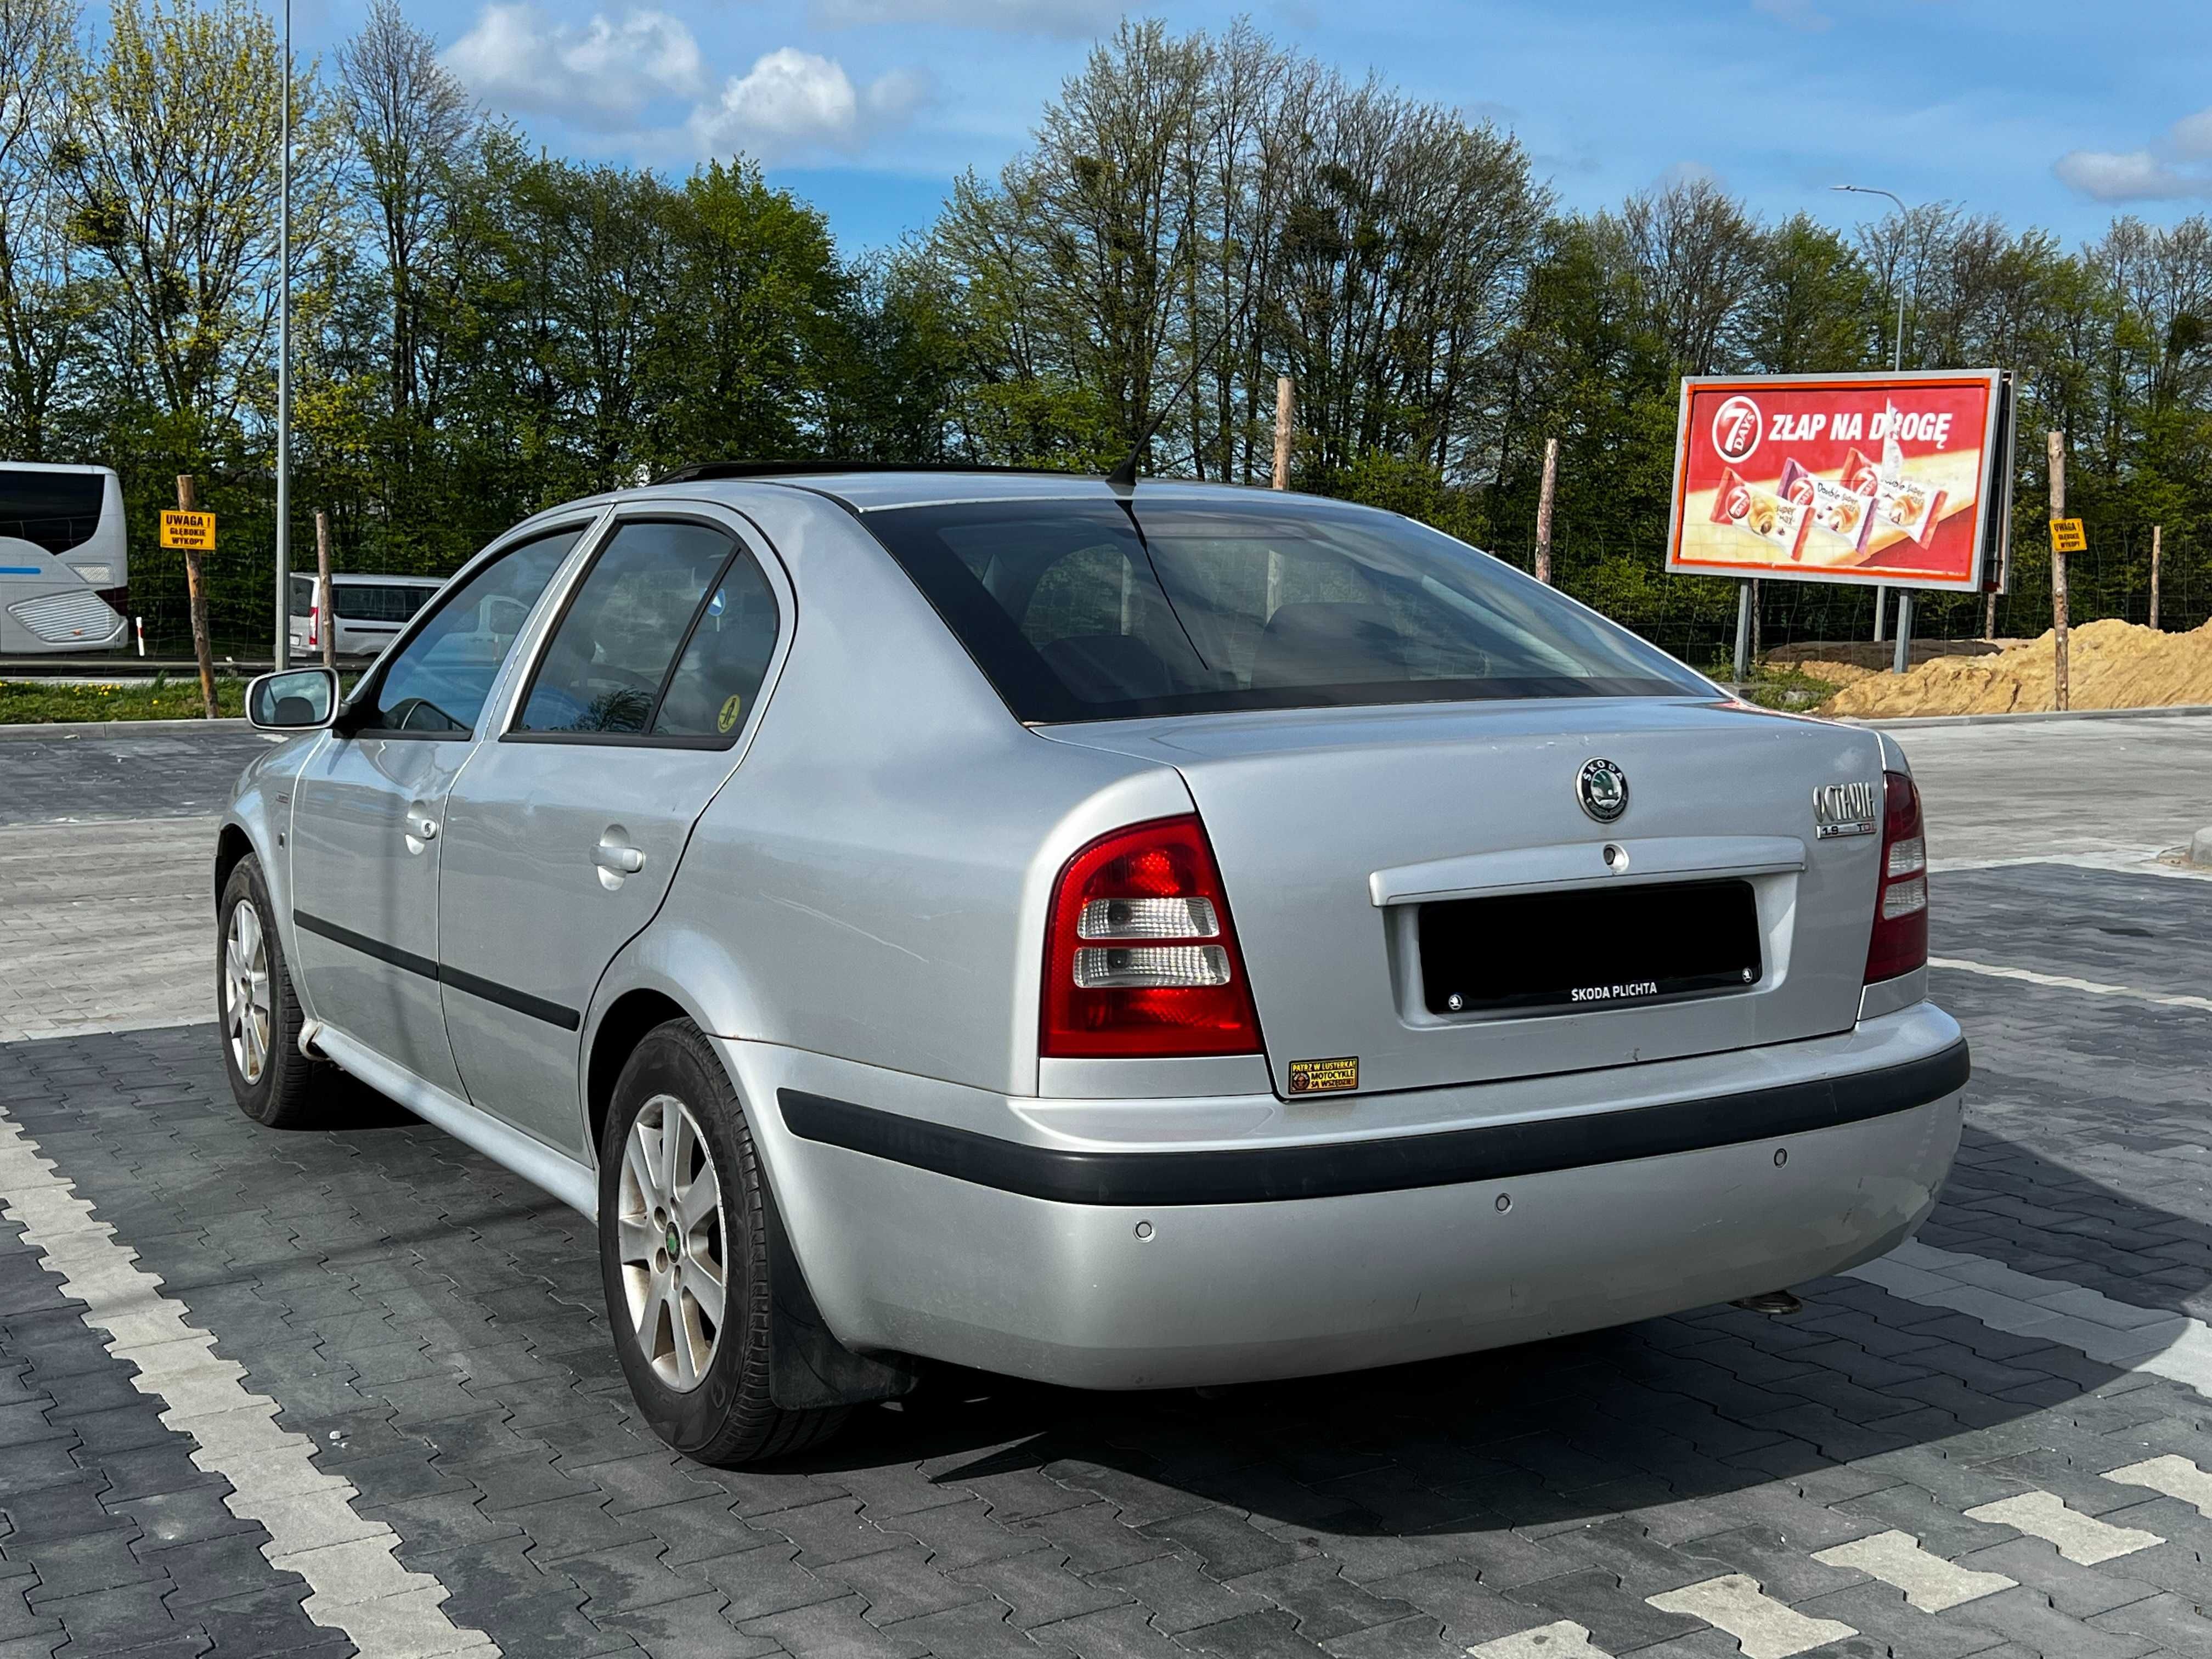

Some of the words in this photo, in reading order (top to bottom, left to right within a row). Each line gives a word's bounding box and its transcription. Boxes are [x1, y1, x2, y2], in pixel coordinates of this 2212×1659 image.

[1719, 408, 1749, 453] 7
[1733, 410, 1756, 451] DAYS
[1768, 413, 1826, 441] ZŁAP
[1830, 413, 1862, 440] NA
[1817, 482, 1840, 500] Double
[1729, 489, 1748, 514] 7
[166, 514, 204, 526] UWAGA
[170, 527, 206, 538] GŁĘBOKIE
[172, 537, 204, 546] WYKOPY
[1813, 782, 1875, 823] OCTAVIA
[1821, 826, 1839, 836] 1.9
[1612, 982, 1657, 997] PLICHTA
[1293, 1063, 1312, 1071] PATRZ
[1311, 1069, 1354, 1080] MOTOCYKLE
